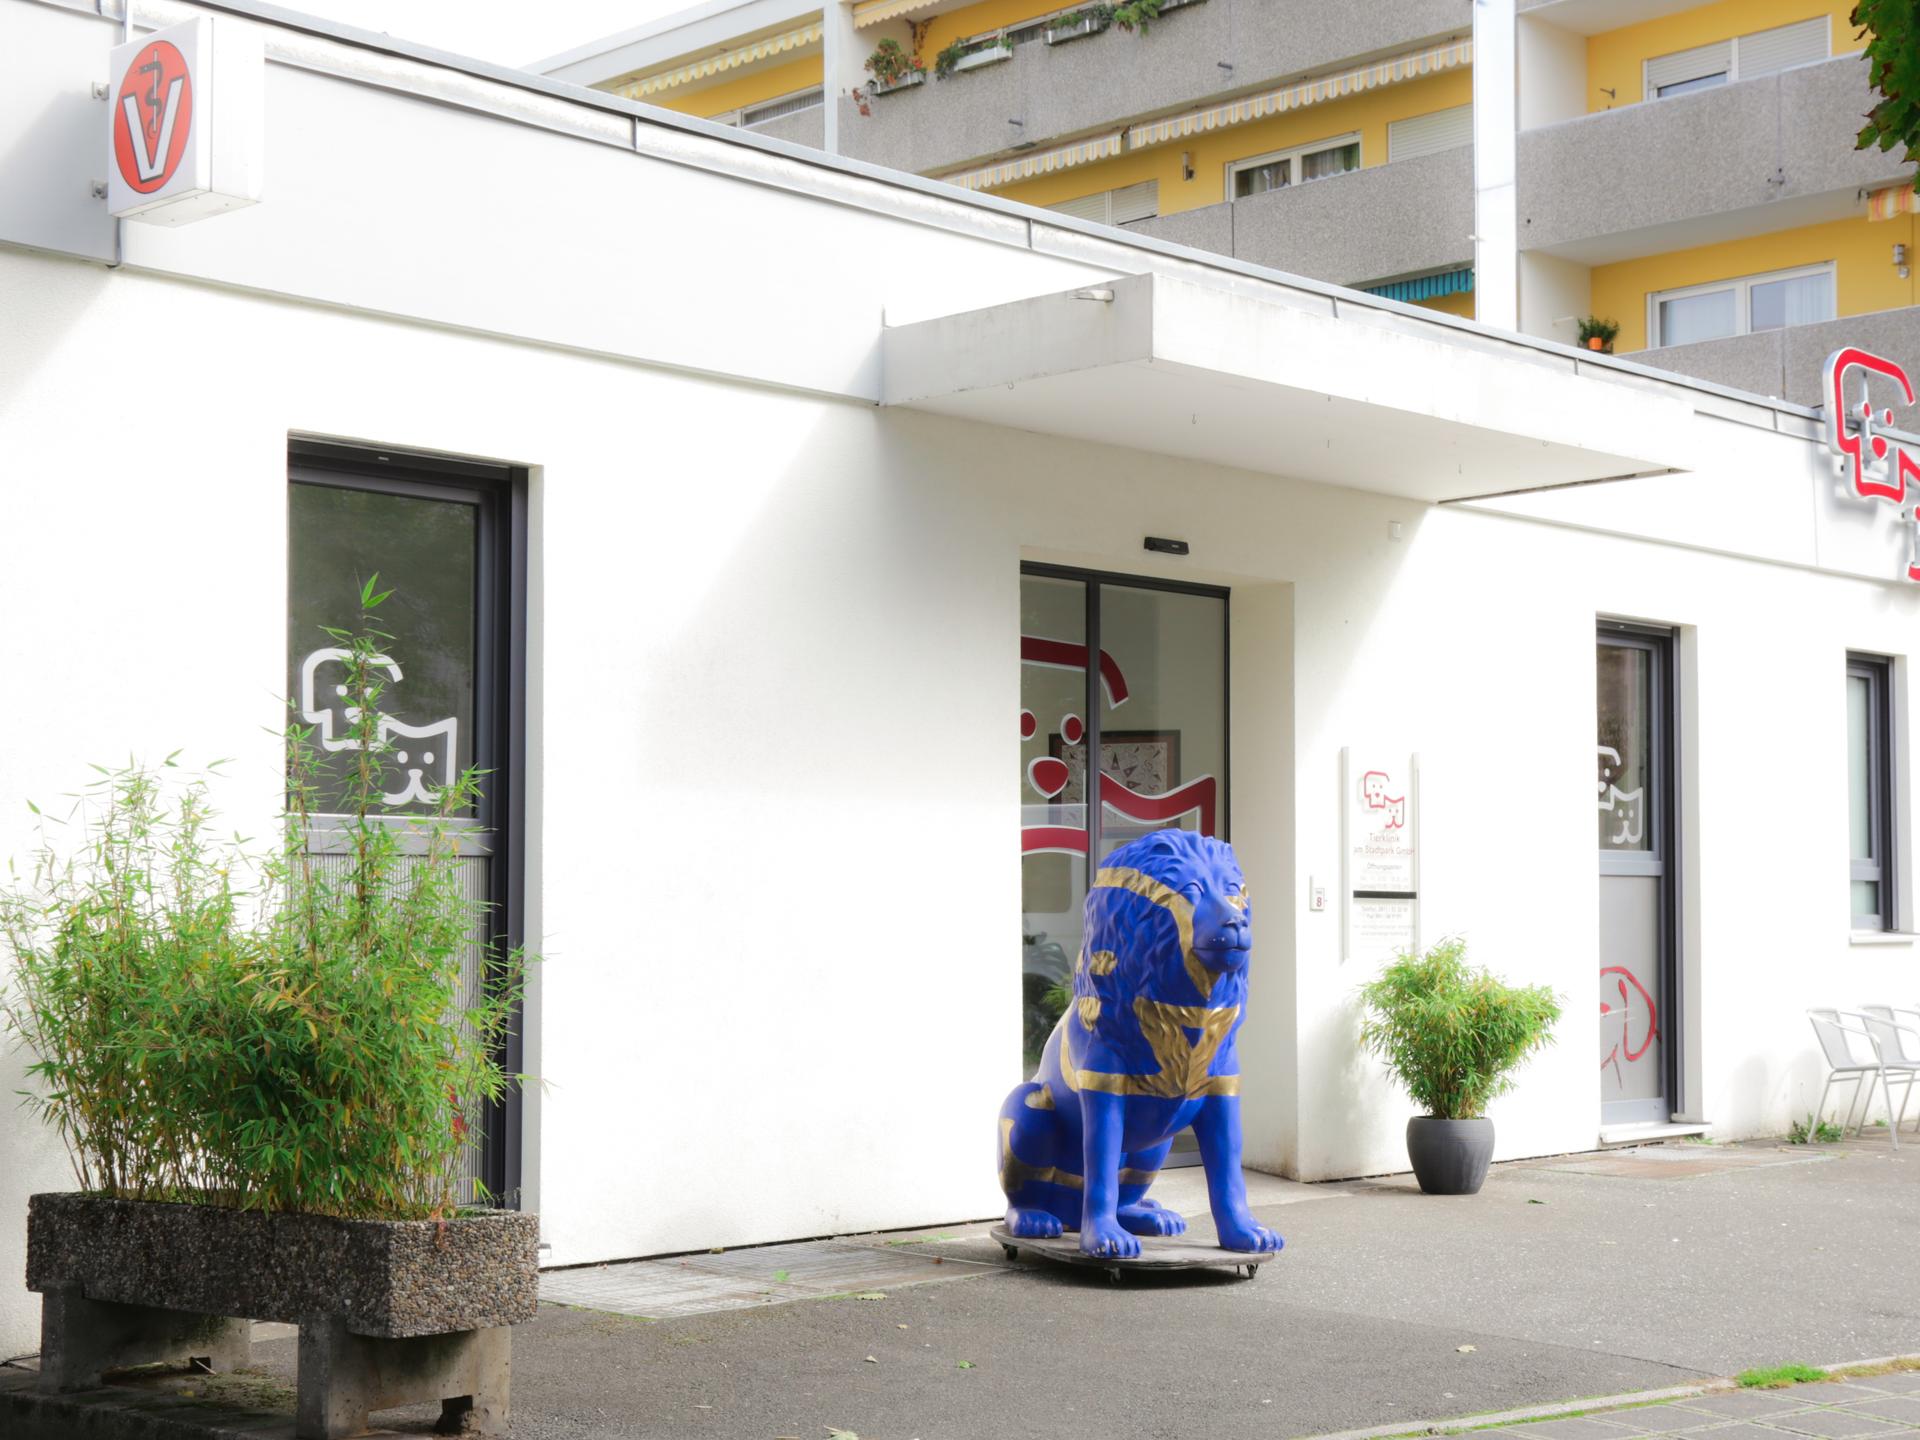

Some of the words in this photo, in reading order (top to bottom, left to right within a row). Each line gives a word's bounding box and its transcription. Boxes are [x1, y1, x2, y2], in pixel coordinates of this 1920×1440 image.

[122, 75, 185, 184] V
[1369, 832, 1400, 841] Tierklinik
[1365, 845, 1394, 856] Stadtpark
[1396, 847, 1415, 855] GmbH
[1316, 896, 1322, 907] 8
